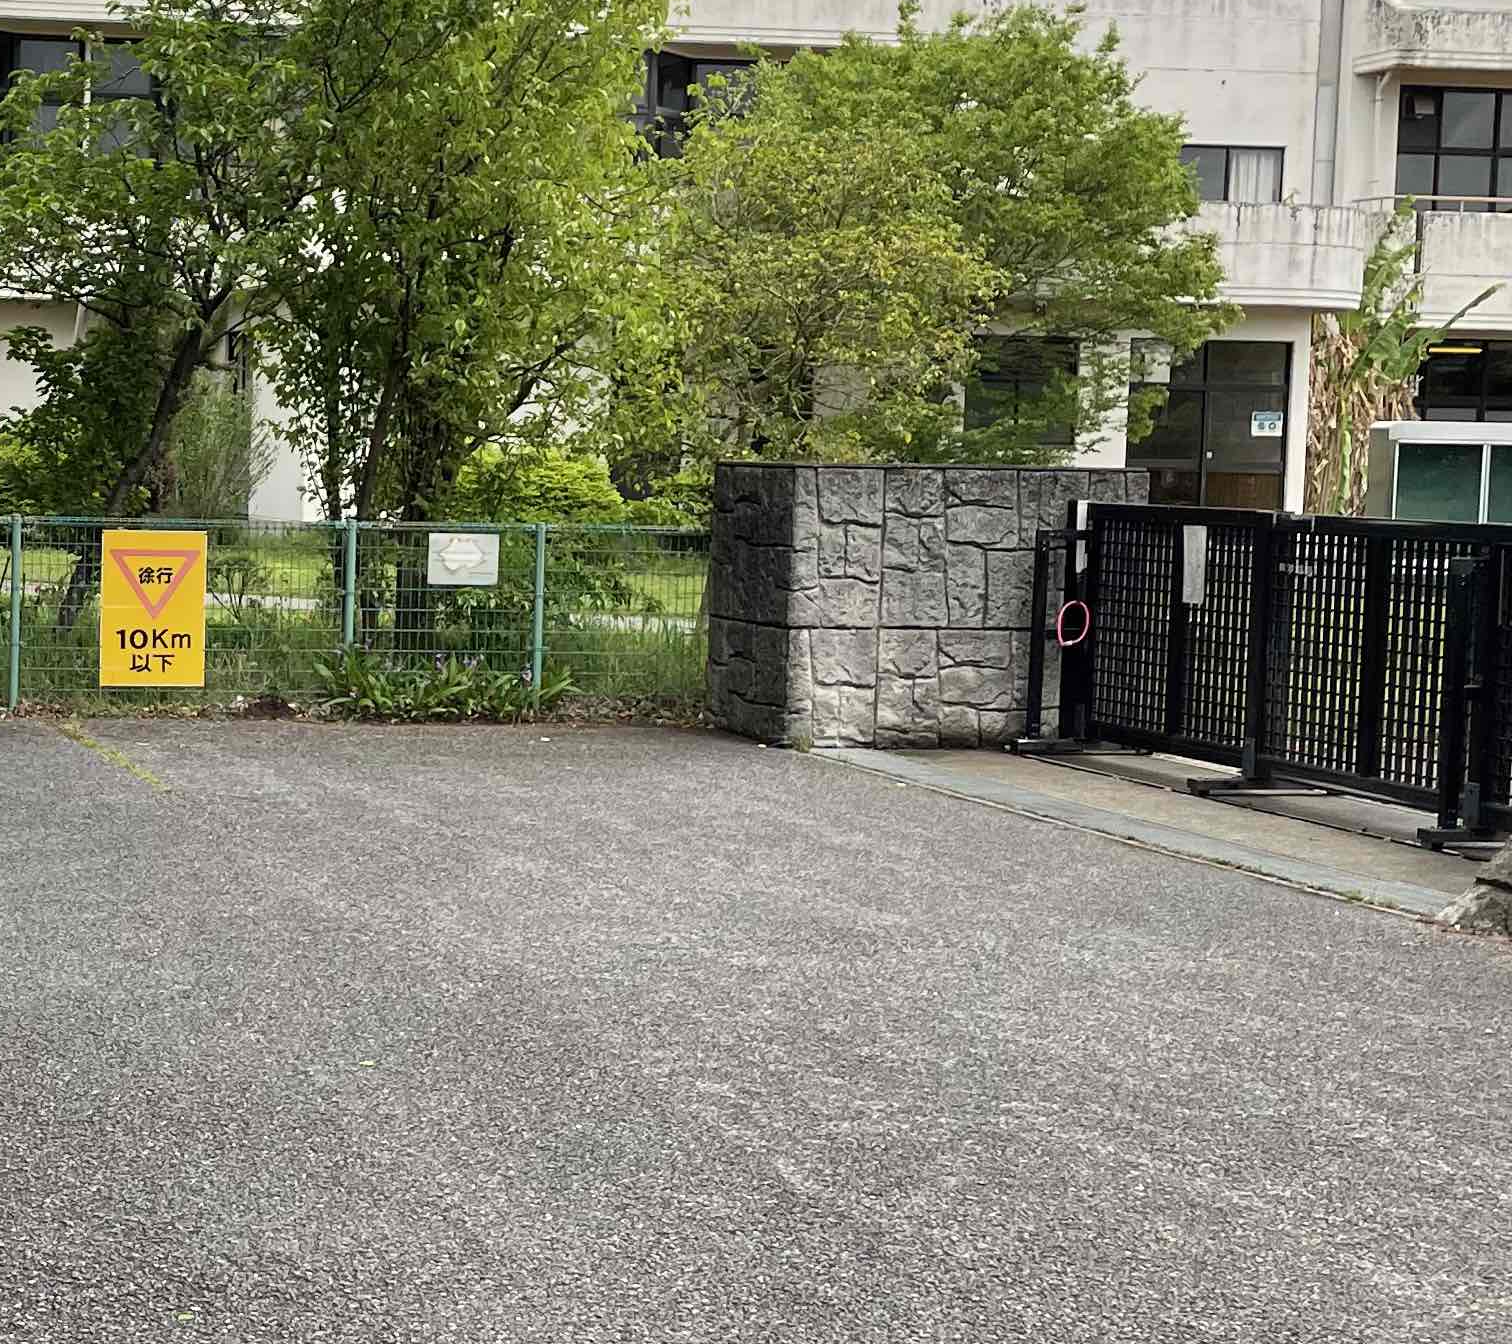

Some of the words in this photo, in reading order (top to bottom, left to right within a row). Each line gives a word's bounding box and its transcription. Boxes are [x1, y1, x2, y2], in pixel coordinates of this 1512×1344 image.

[138, 567, 173, 584] 徐行
[116, 629, 191, 649] 10Km
[130, 654, 175, 672] 以下
